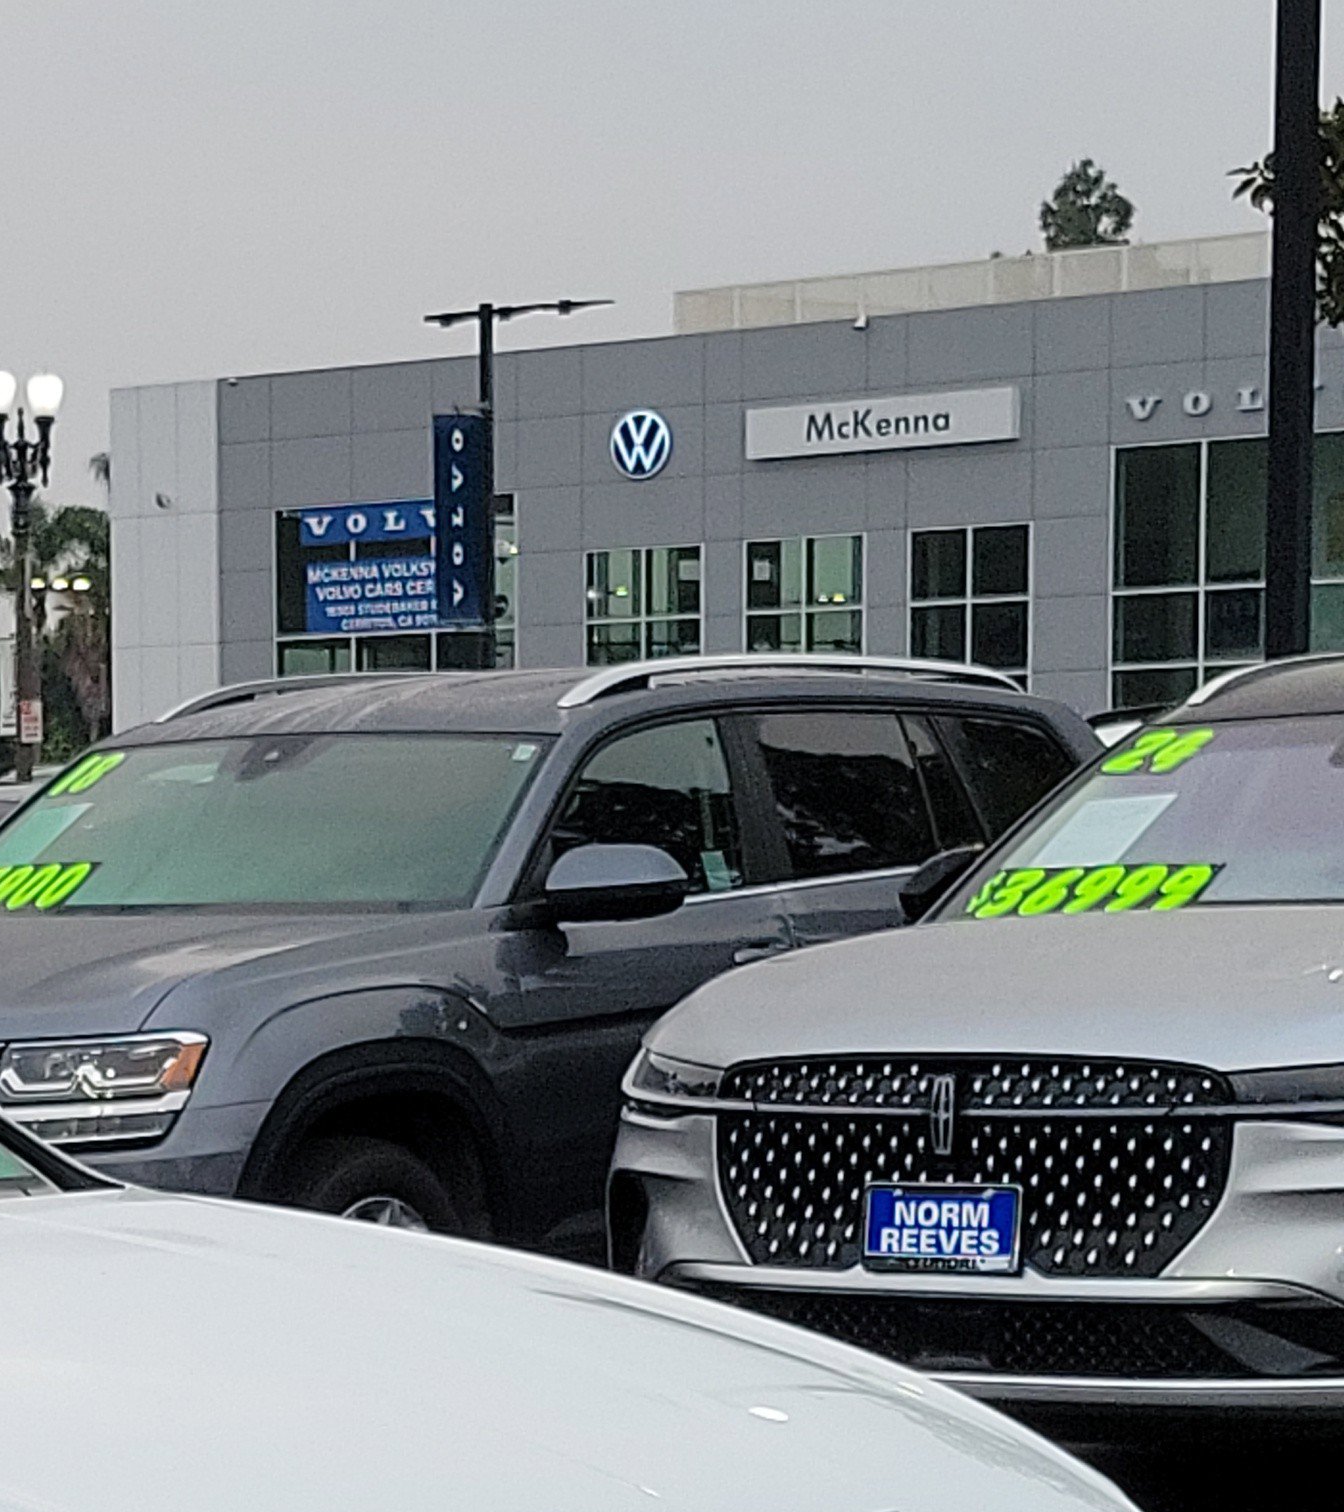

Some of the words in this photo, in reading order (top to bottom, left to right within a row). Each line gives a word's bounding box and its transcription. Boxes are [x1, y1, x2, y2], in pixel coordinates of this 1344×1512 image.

[806, 409, 952, 442] McKenna
[451, 428, 464, 607] VOLVO
[315, 583, 362, 601] VOLVO
[364, 580, 403, 598] CARS
[965, 864, 1214, 919] $36999
[893, 1200, 991, 1229] NORM
[879, 1227, 1001, 1256] REEVES
